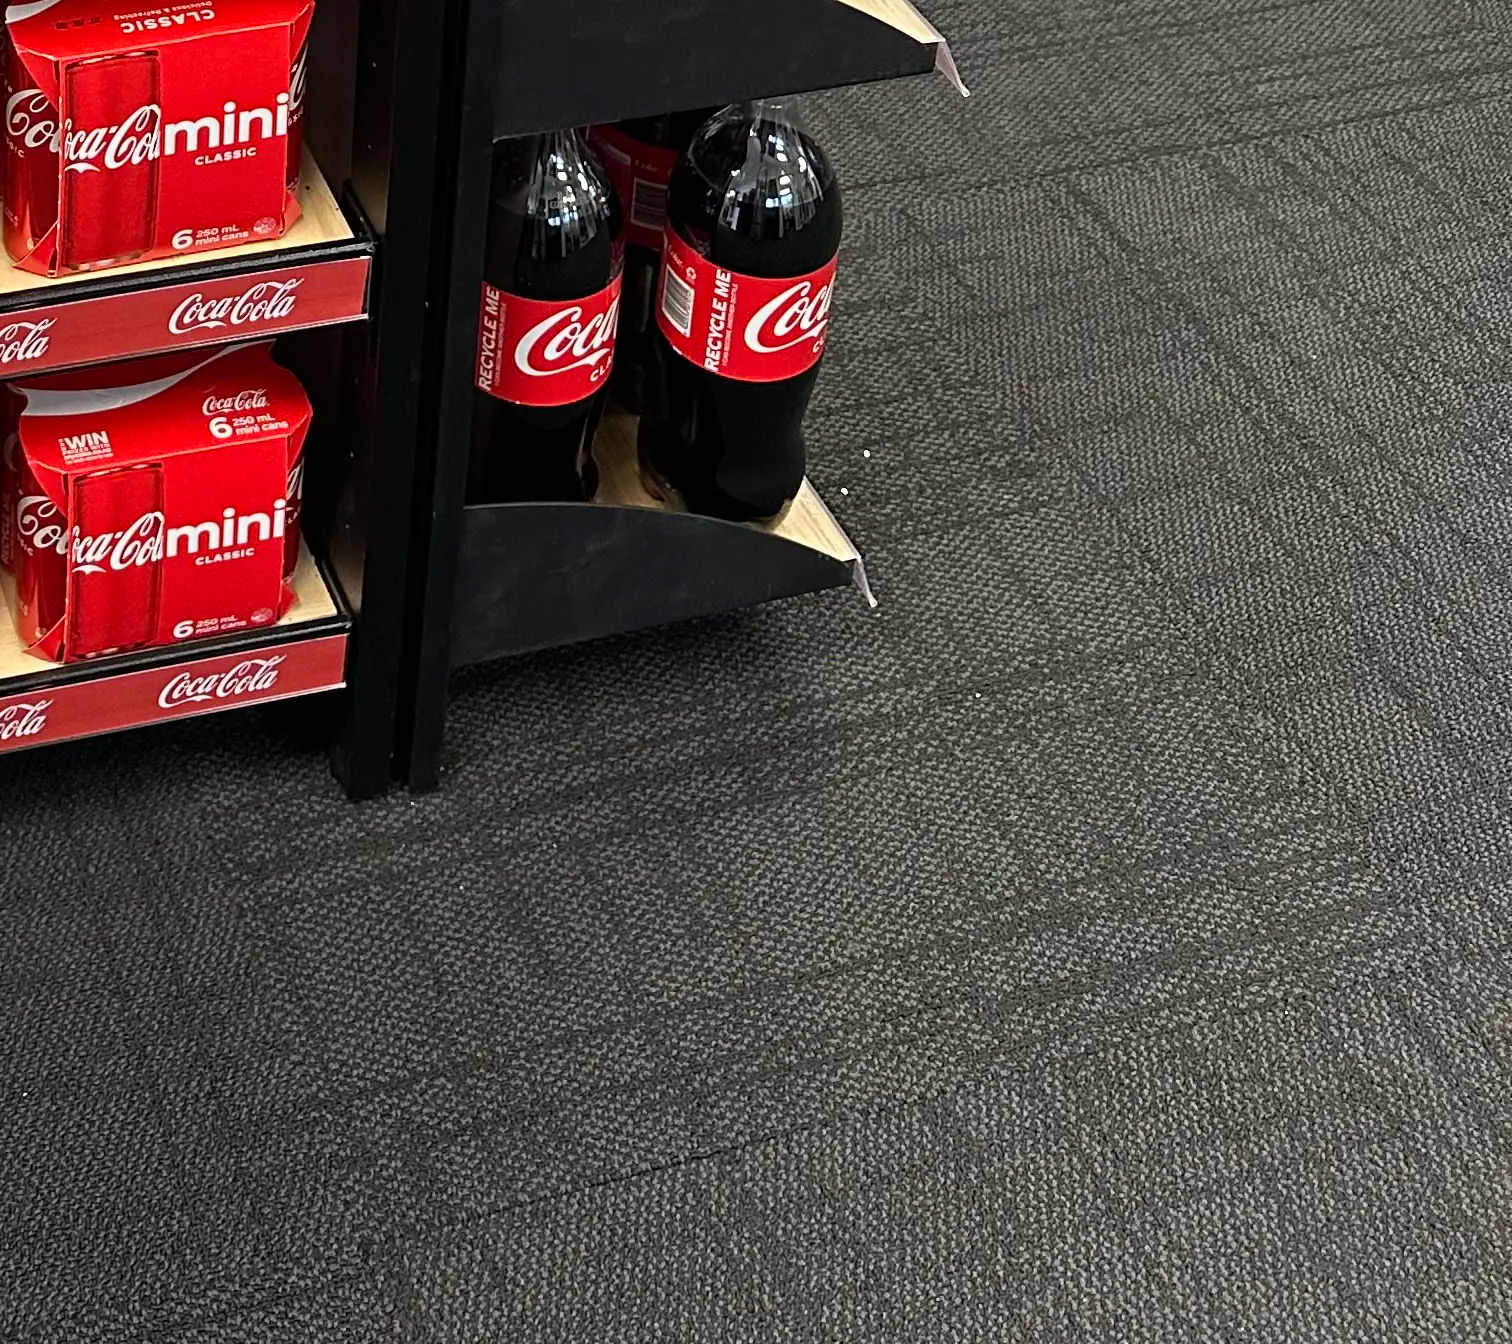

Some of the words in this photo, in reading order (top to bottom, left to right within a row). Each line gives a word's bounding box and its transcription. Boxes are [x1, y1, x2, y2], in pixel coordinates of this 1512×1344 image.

[165, 92, 289, 155] mini
[194, 147, 257, 166] CLASSIC
[169, 279, 301, 334] Coca-Cola
[487, 287, 500, 312] ME
[704, 302, 728, 373] RECYCLE
[718, 270, 731, 299] ME
[478, 316, 498, 391] RECYCLE
[168, 499, 287, 558] mini
[196, 548, 255, 565] CLASSIC
[159, 656, 284, 707] Coca-Cola
